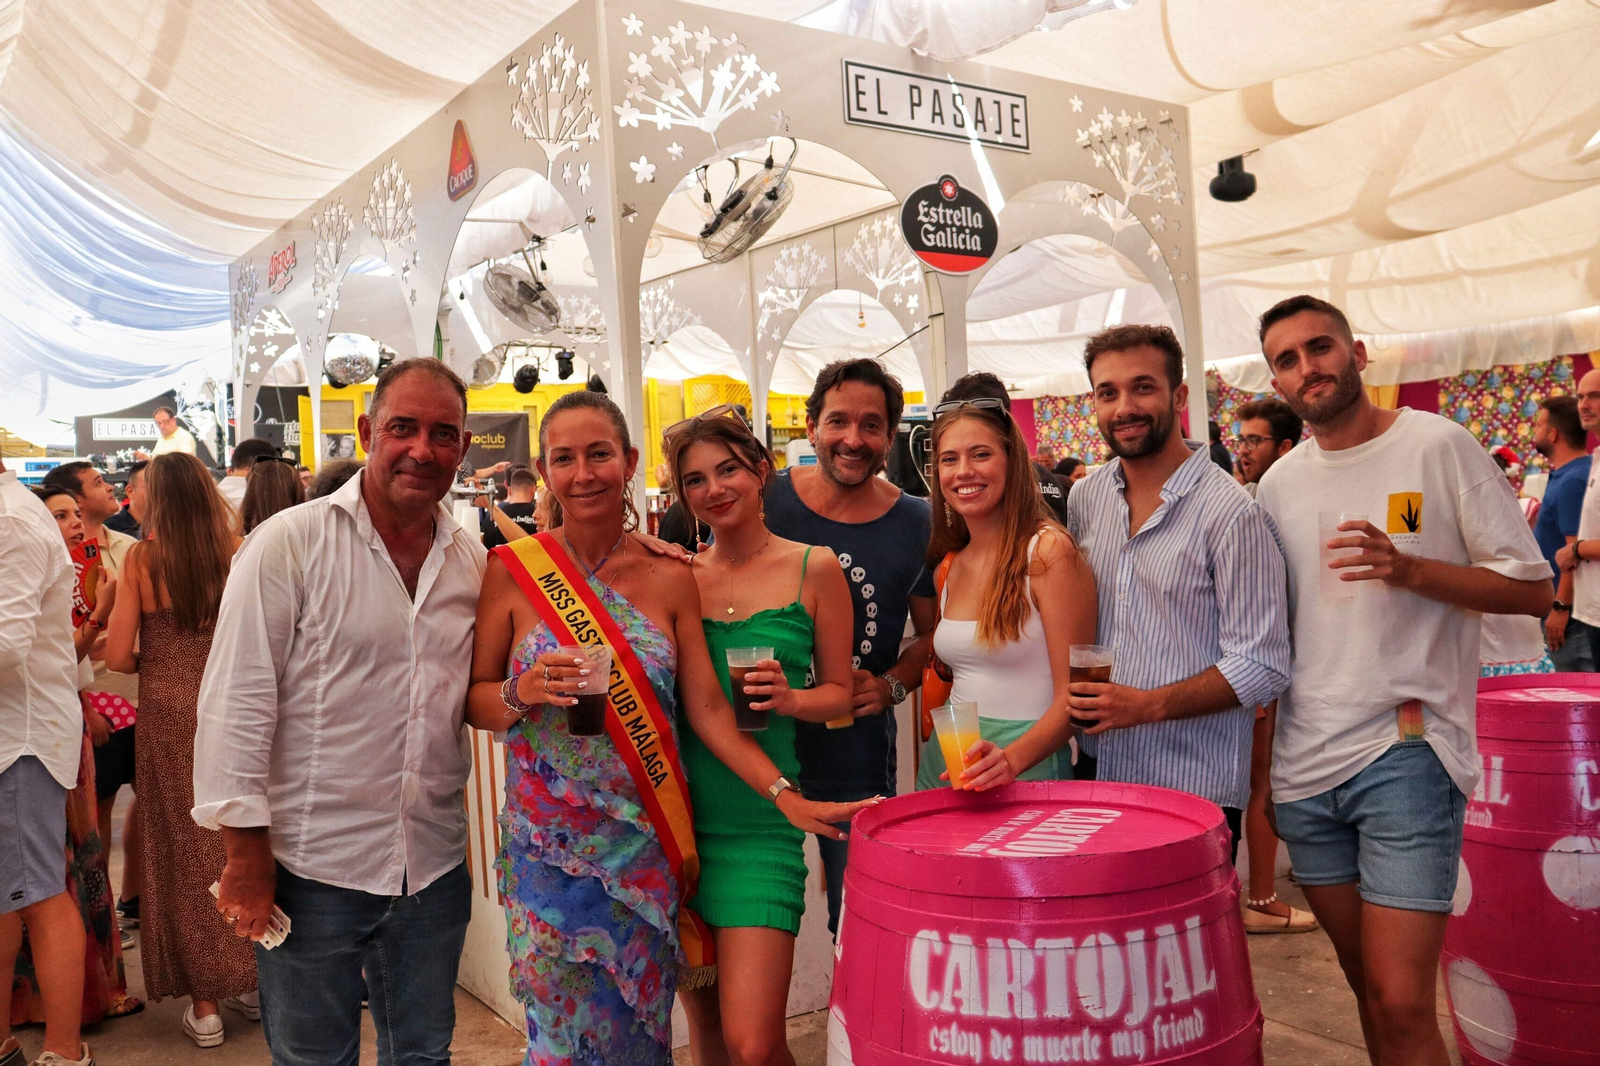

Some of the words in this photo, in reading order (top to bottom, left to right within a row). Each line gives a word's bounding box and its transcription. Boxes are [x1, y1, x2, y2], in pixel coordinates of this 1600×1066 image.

[854, 73, 889, 116] EL
[908, 83, 1022, 139] PASAJE
[449, 163, 474, 193] CACIQUE
[917, 199, 984, 229] Estrella
[920, 223, 982, 251] Galicia
[268, 243, 296, 287] APEROL
[98, 423, 112, 436] EL
[537, 571, 576, 611] MISS
[624, 714, 669, 790] MÁLAGA
[909, 914, 1217, 1024] CARTOJAL
[929, 1021, 983, 1064] estoy
[990, 1027, 1013, 1062] de
[1023, 1025, 1101, 1062] muerte
[1110, 1029, 1146, 1062] my
[1152, 1007, 1205, 1057] friend
